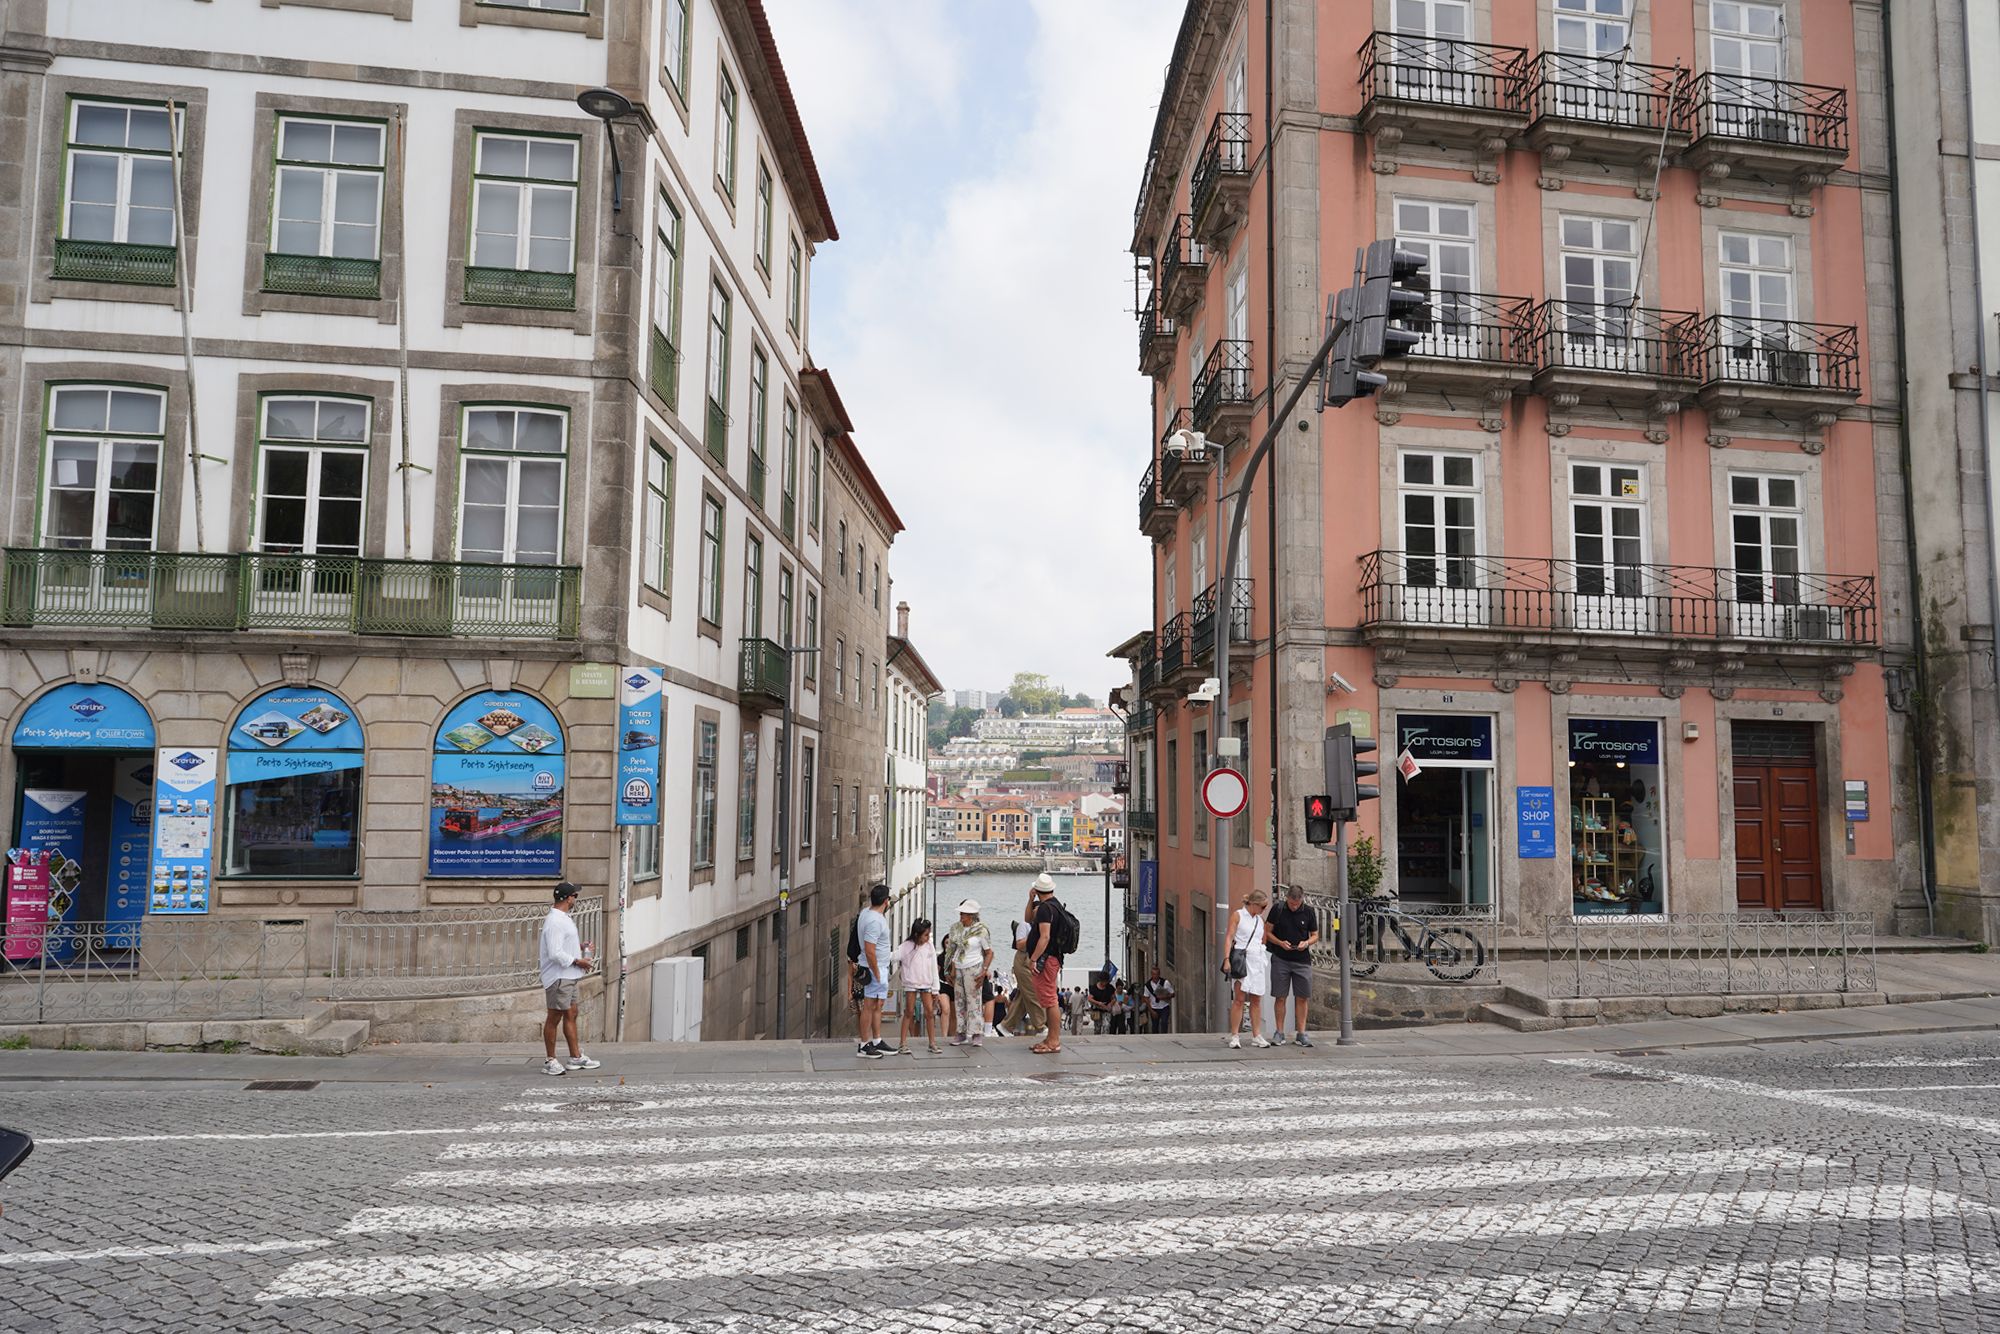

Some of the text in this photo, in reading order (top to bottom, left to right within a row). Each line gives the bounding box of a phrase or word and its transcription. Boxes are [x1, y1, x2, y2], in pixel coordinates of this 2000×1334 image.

[628, 710, 652, 718] TICKETS
[23, 727, 92, 739] Porto Sightseeing
[256, 756, 334, 770] Porto Sightseeing
[461, 758, 535, 772] Porto Sightseeing
[1522, 811, 1550, 821] SHOP
